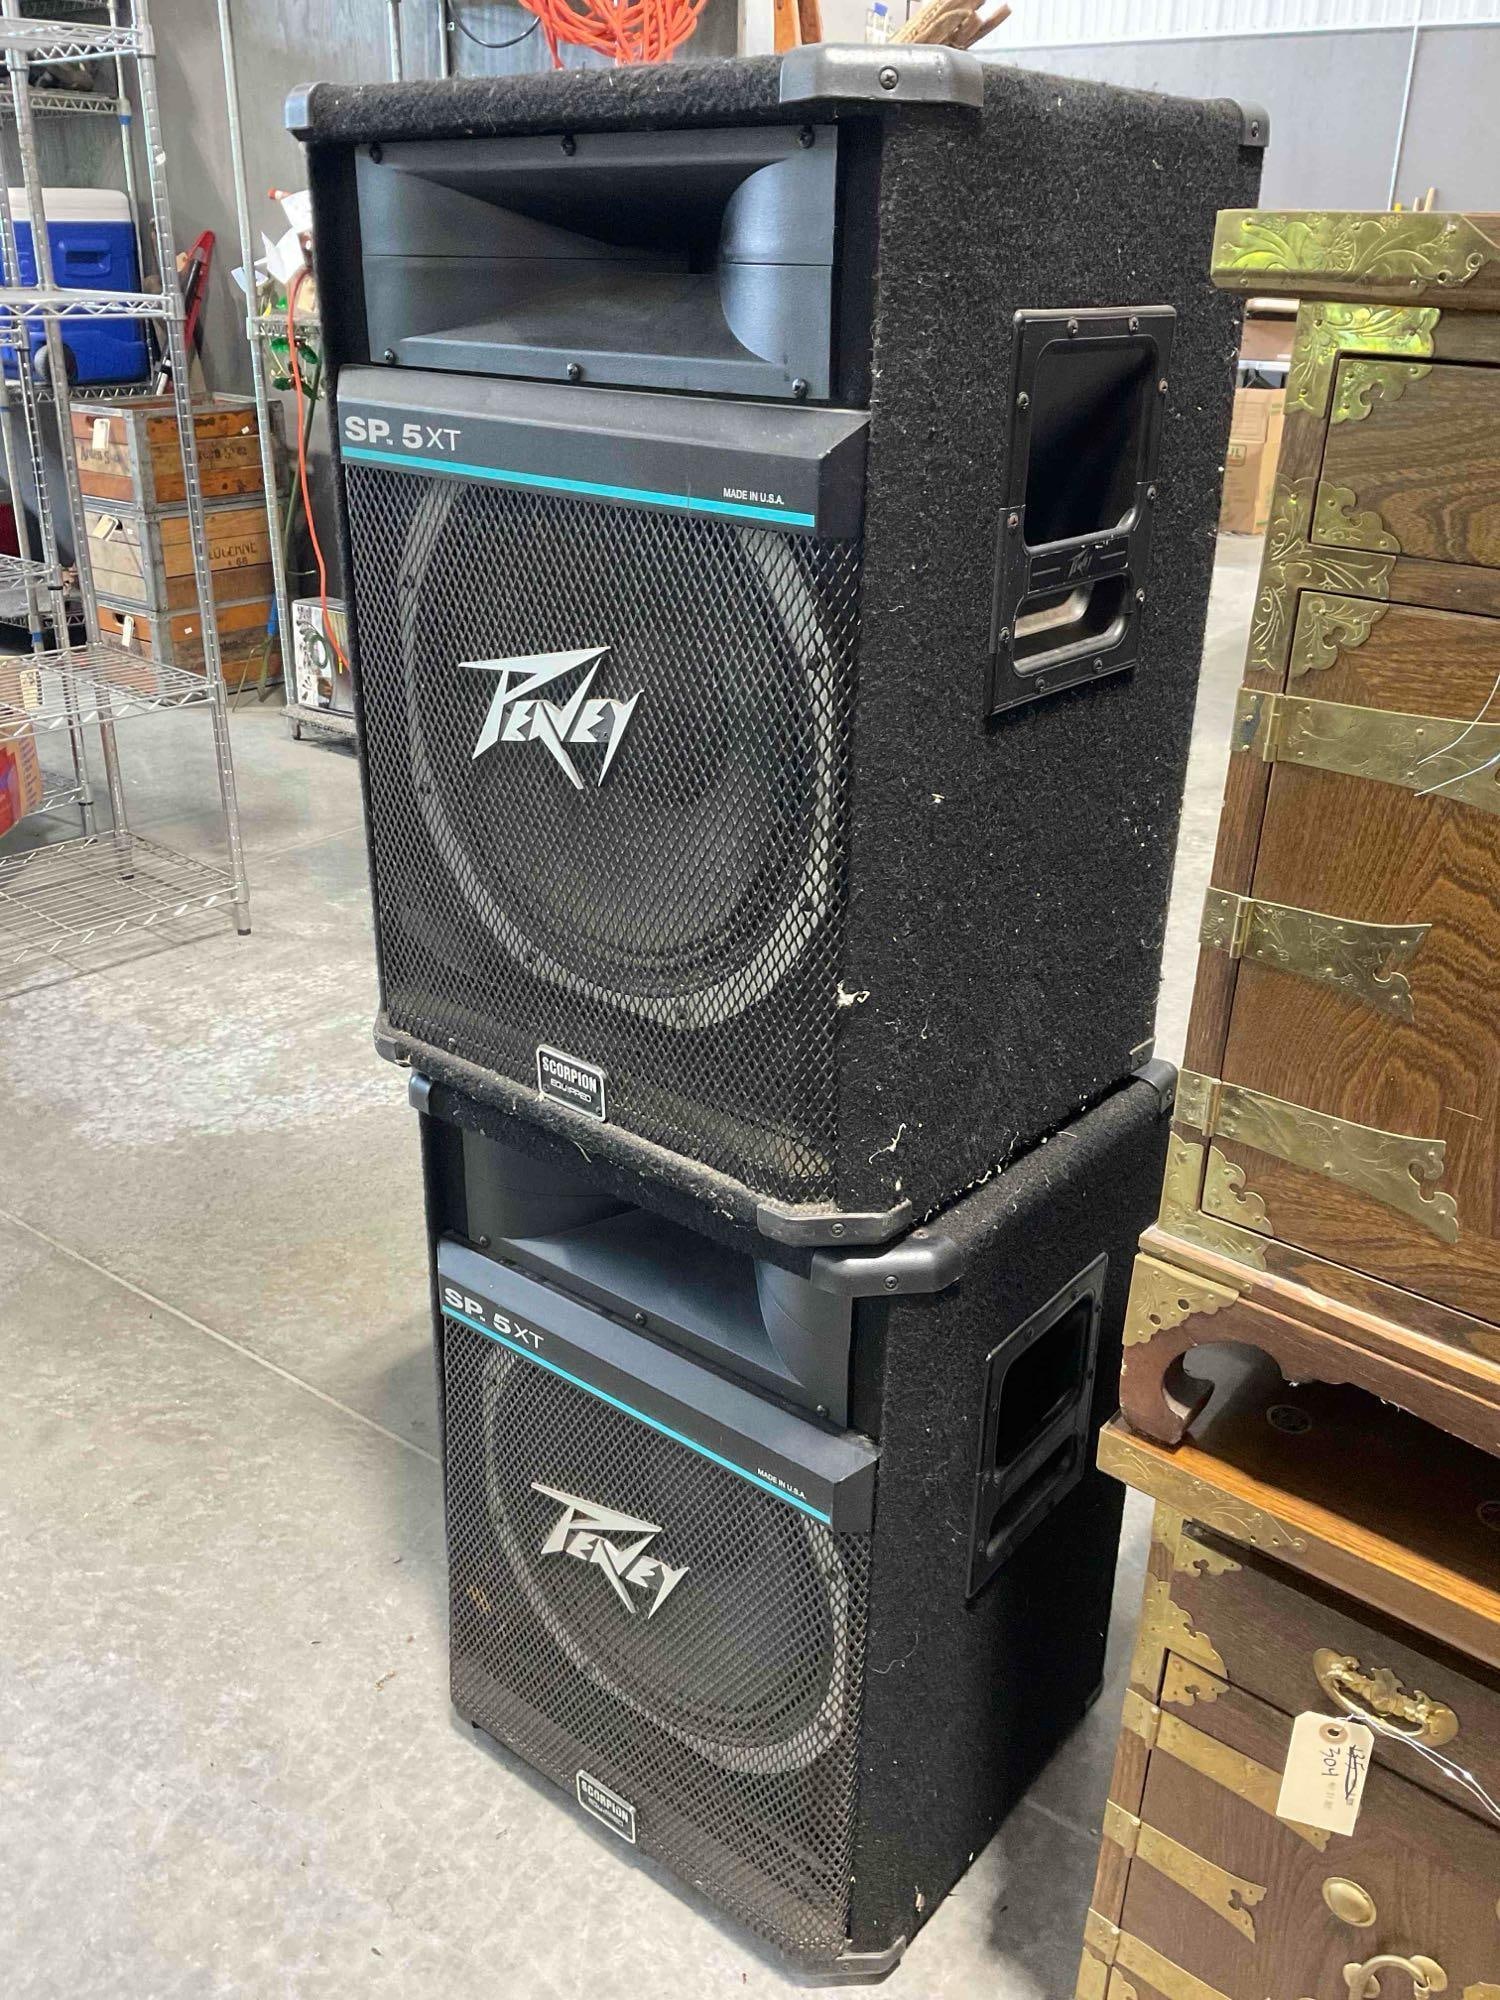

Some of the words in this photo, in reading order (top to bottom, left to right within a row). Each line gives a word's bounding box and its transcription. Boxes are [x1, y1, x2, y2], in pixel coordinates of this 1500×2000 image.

[723, 487, 748, 500] MADE
[749, 491, 759, 502] IN
[542, 1056, 597, 1093] SCORPION
[757, 1467, 778, 1484] MADE
[778, 1479, 786, 1489] IN
[581, 1780, 629, 1823] SCORPION
